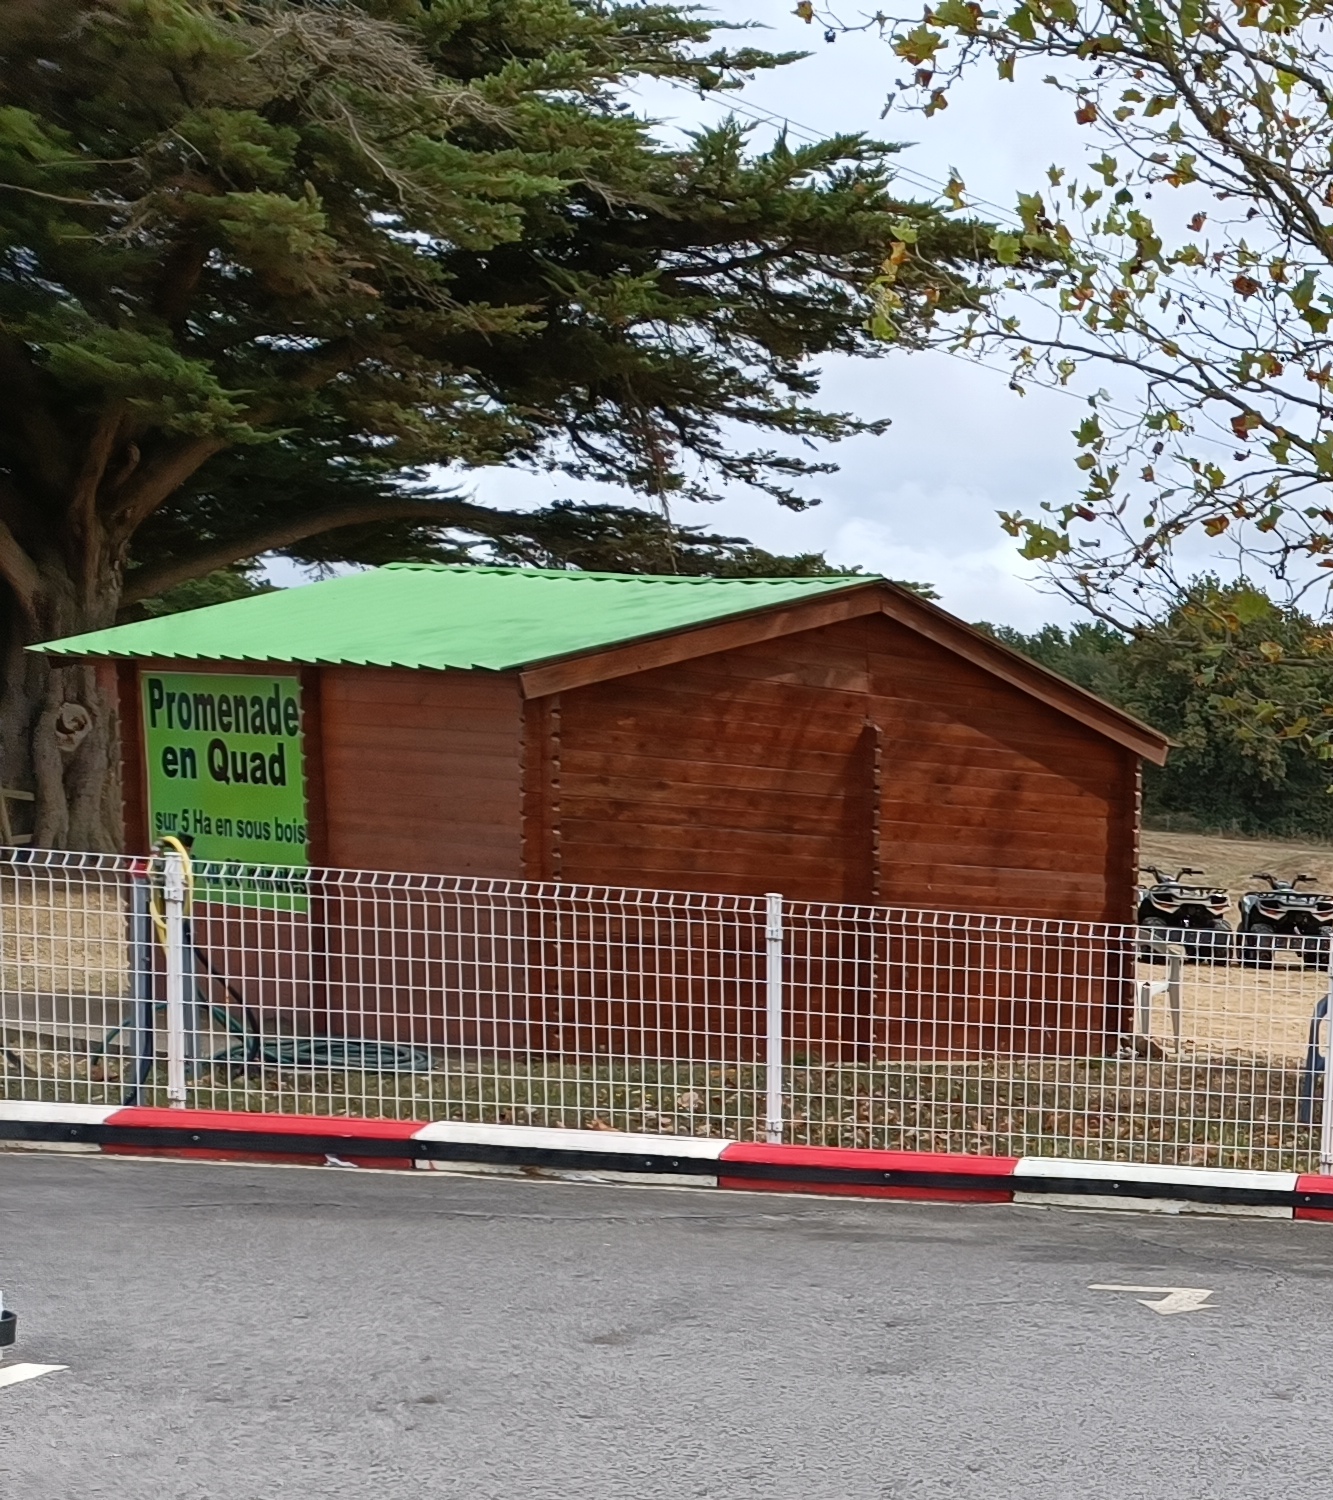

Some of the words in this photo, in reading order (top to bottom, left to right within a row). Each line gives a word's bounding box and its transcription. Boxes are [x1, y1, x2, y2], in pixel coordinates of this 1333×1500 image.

[148, 678, 300, 737] Promenade
[162, 746, 197, 779] en
[207, 738, 287, 786] Quad
[155, 809, 177, 831] sur
[181, 808, 190, 833] 5
[193, 809, 212, 836] Ha
[216, 816, 232, 837] en
[237, 818, 271, 841] sous
[275, 816, 306, 844] bois
